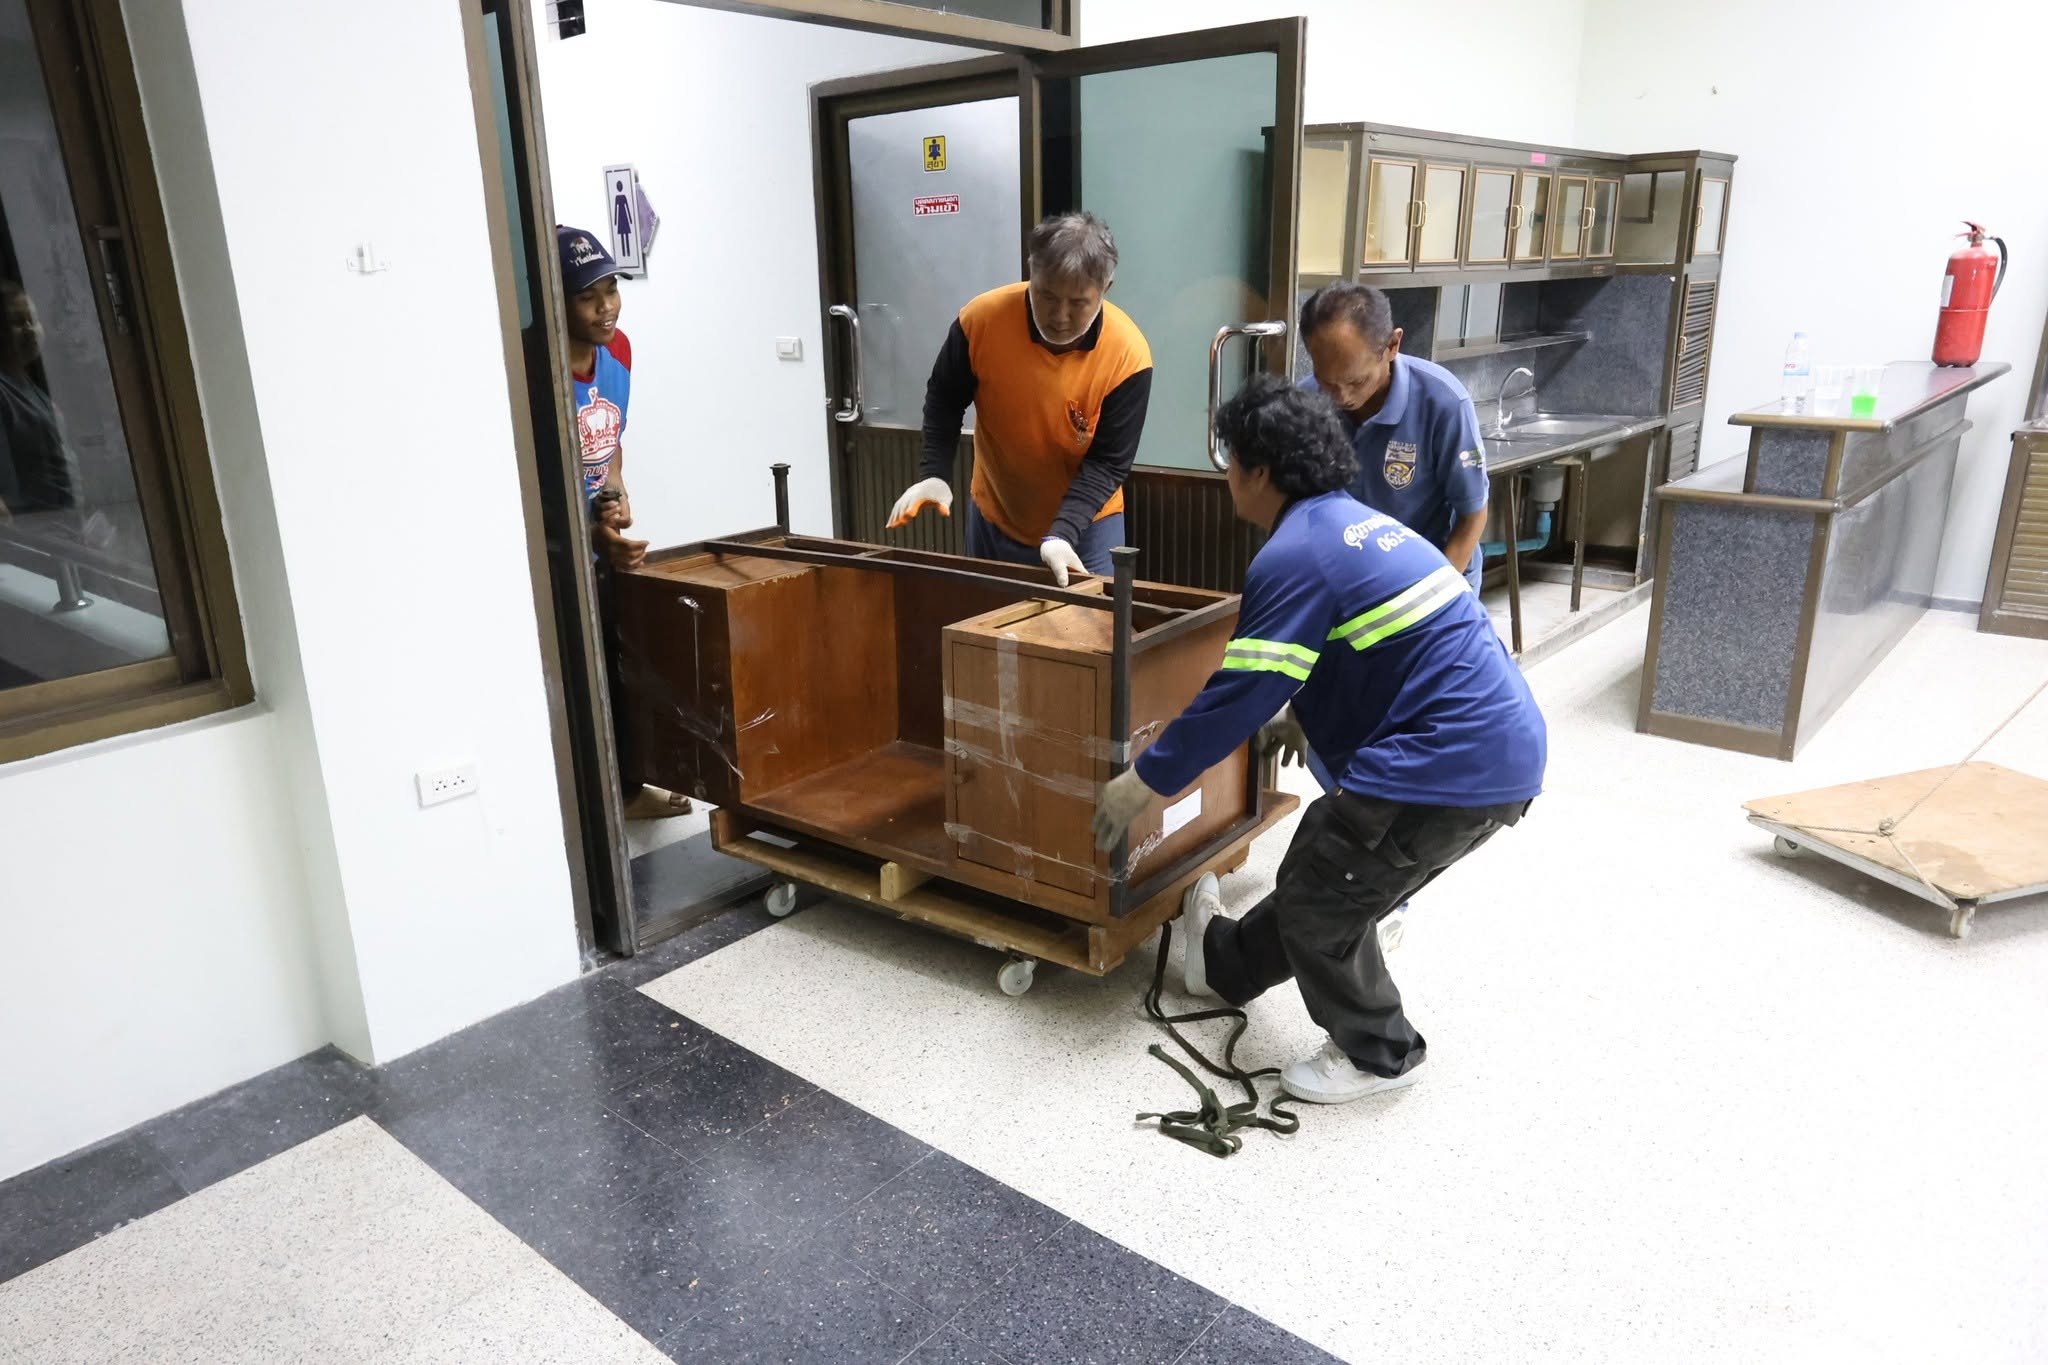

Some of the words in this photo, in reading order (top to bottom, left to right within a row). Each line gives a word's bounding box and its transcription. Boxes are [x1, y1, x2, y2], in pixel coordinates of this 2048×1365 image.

[927, 160, 944, 169] สุขา
[915, 203, 957, 214] ห้ามเข้า
